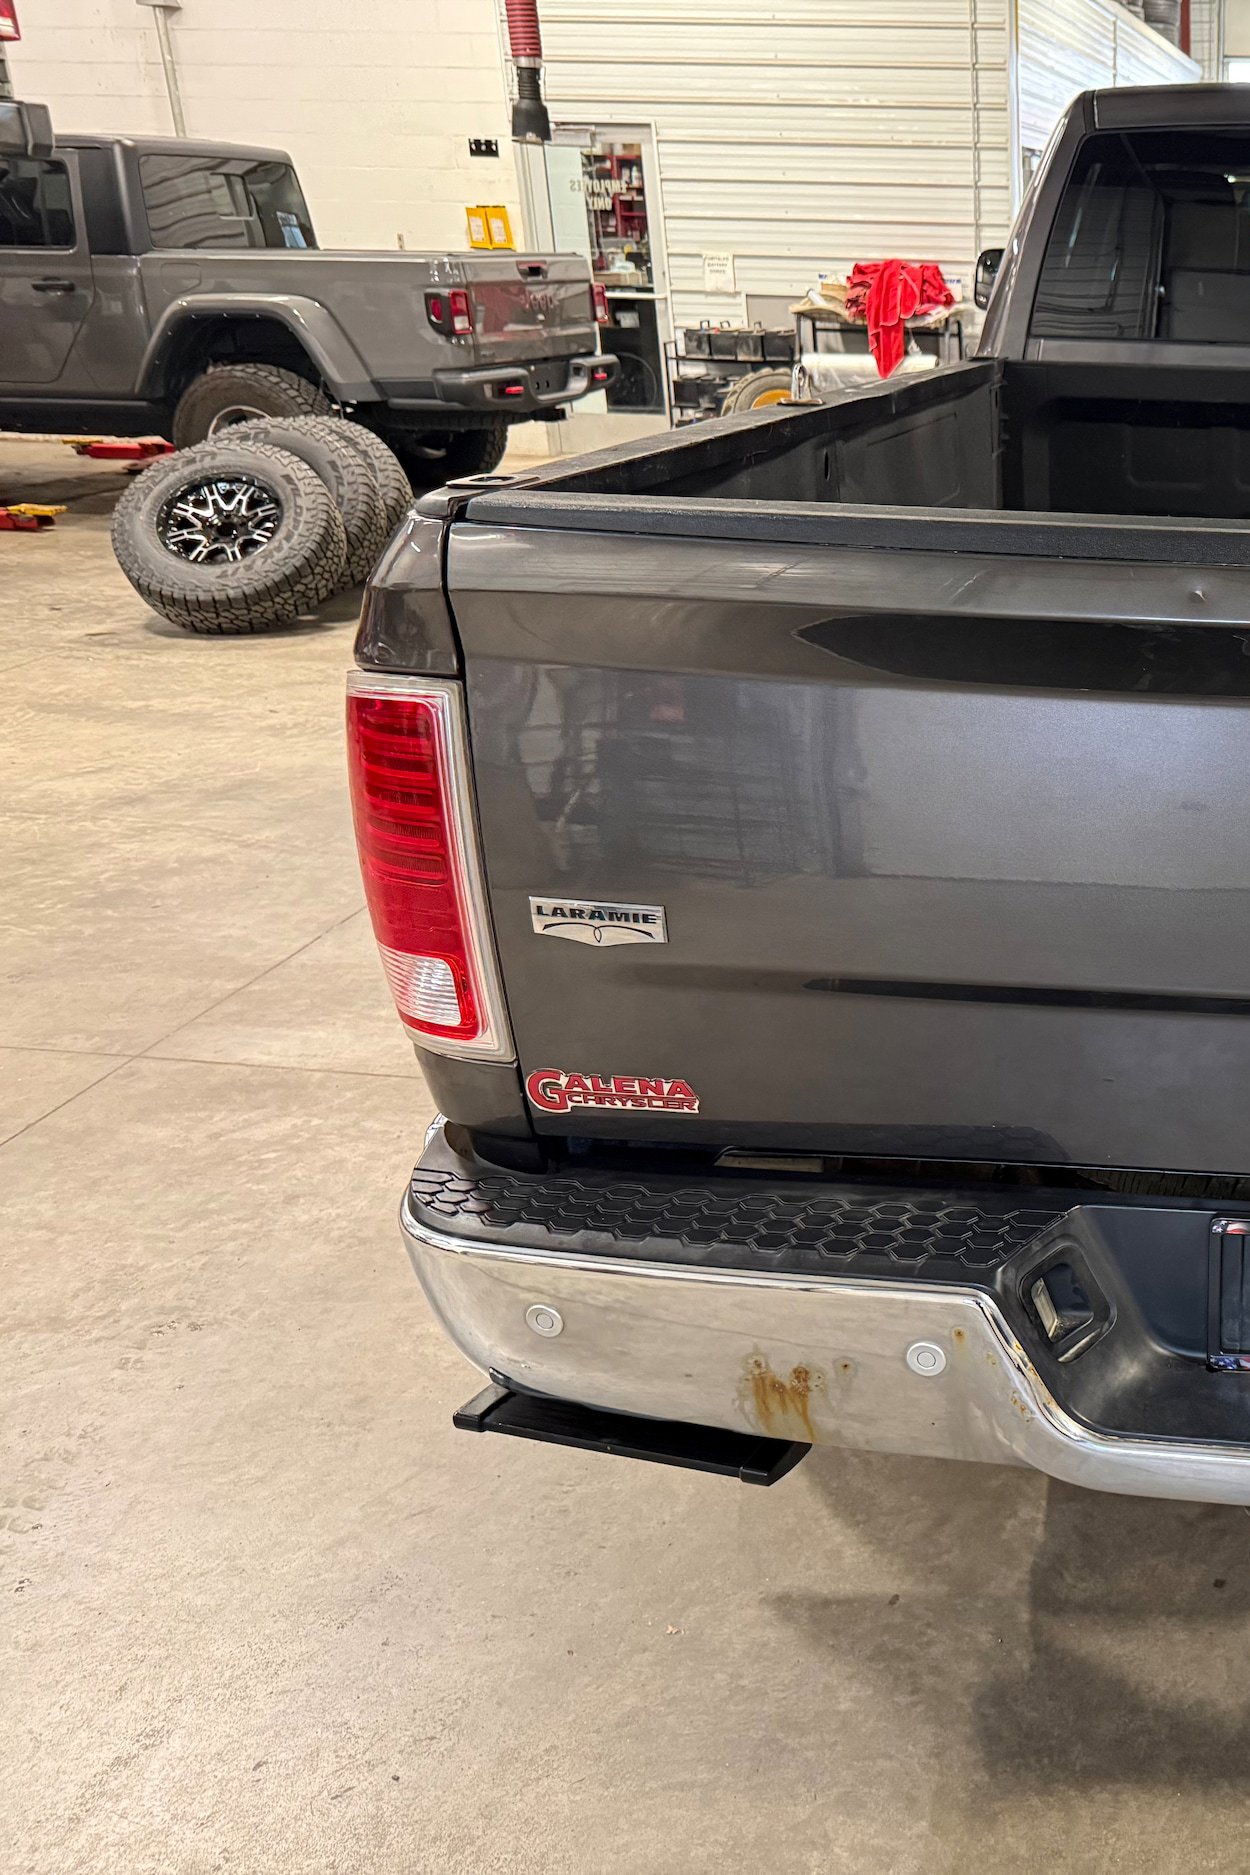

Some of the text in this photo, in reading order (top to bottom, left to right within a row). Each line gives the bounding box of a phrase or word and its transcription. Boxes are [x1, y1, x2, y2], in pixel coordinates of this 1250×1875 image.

[536, 905, 657, 924] LARAMIE
[527, 1069, 697, 1110] GALENA
[567, 1093, 696, 1111] CHRYSLER
